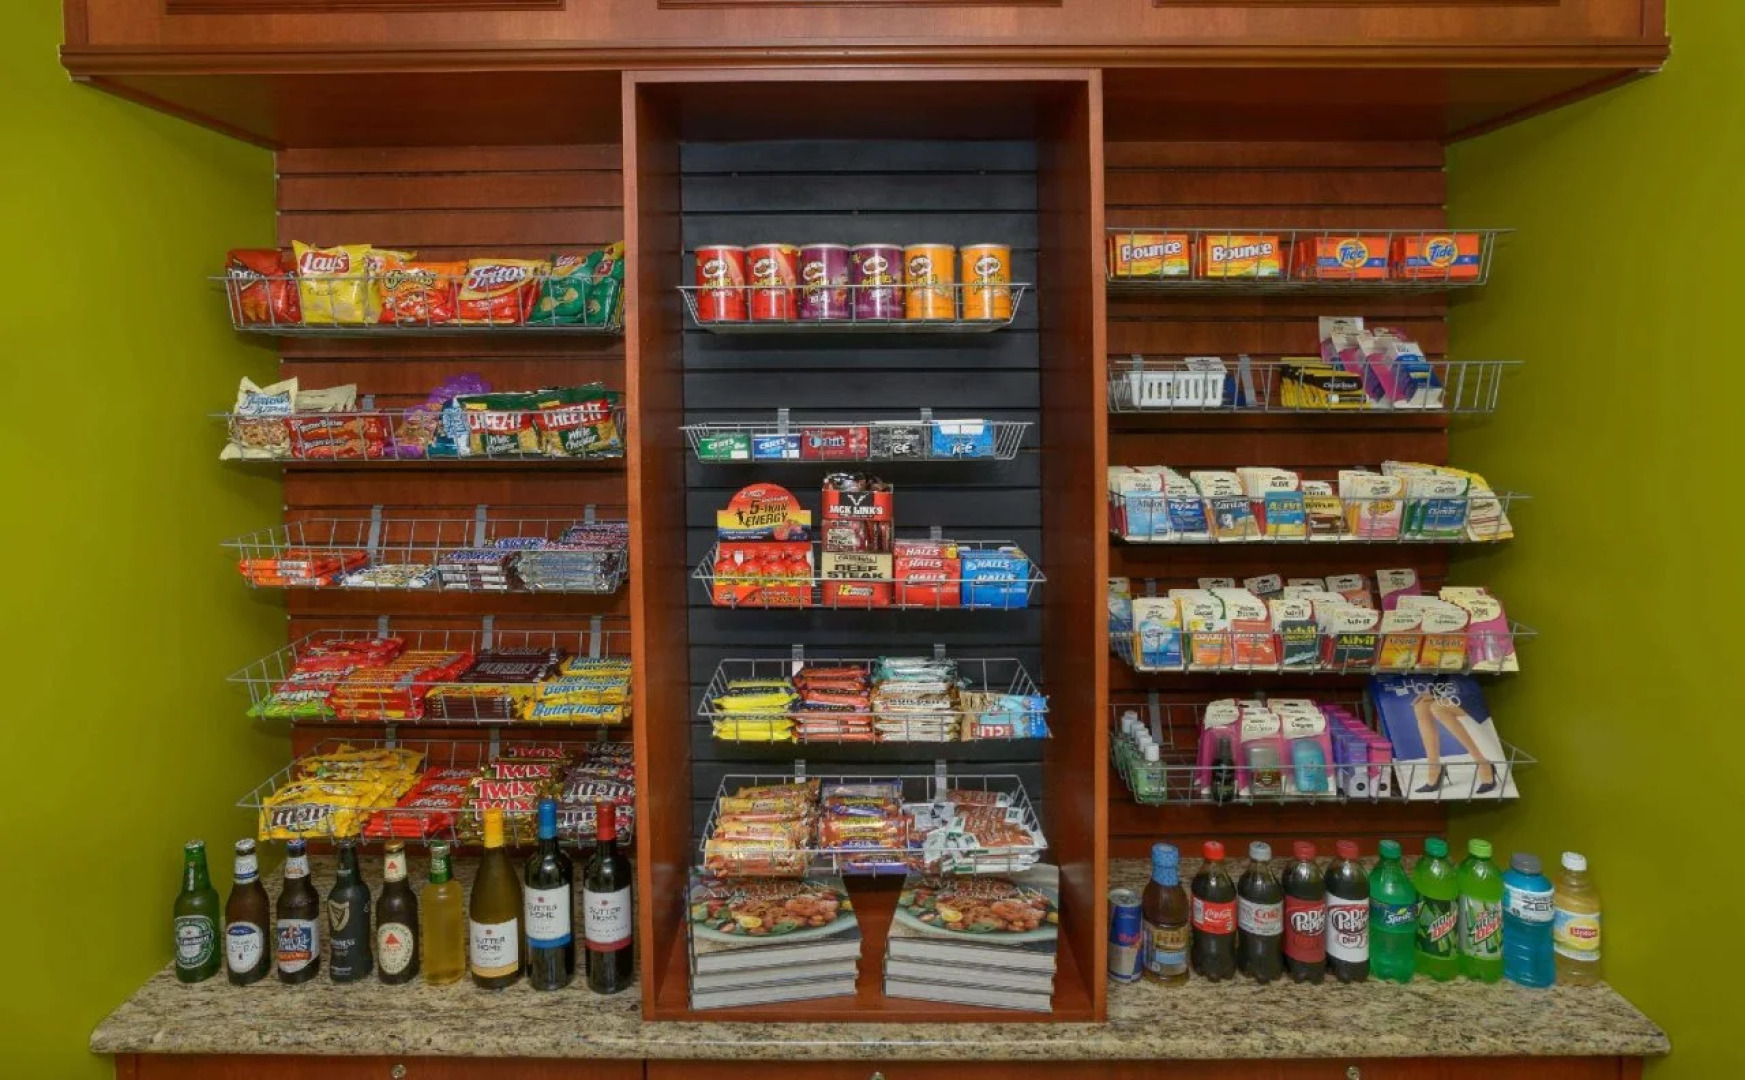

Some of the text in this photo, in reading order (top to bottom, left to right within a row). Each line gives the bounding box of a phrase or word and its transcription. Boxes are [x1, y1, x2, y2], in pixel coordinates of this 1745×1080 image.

[1121, 241, 1182, 262] Bounce
[1212, 242, 1273, 261] Bounce
[1428, 244, 1453, 260] Tide
[468, 264, 526, 288] Fritos
[829, 506, 851, 514] JACK
[745, 513, 788, 527] ENERGY
[906, 548, 940, 556] HALLS
[909, 559, 943, 567] HALLS
[977, 559, 1011, 568] HALLS
[908, 574, 948, 584] HALLS
[976, 574, 1015, 584] HALLS
[1339, 635, 1376, 646] Advil
[533, 704, 616, 718] Butterfinger
[491, 764, 552, 779] TWIX
[479, 780, 537, 799] TWIX
[1573, 929, 1597, 938] Lipton
